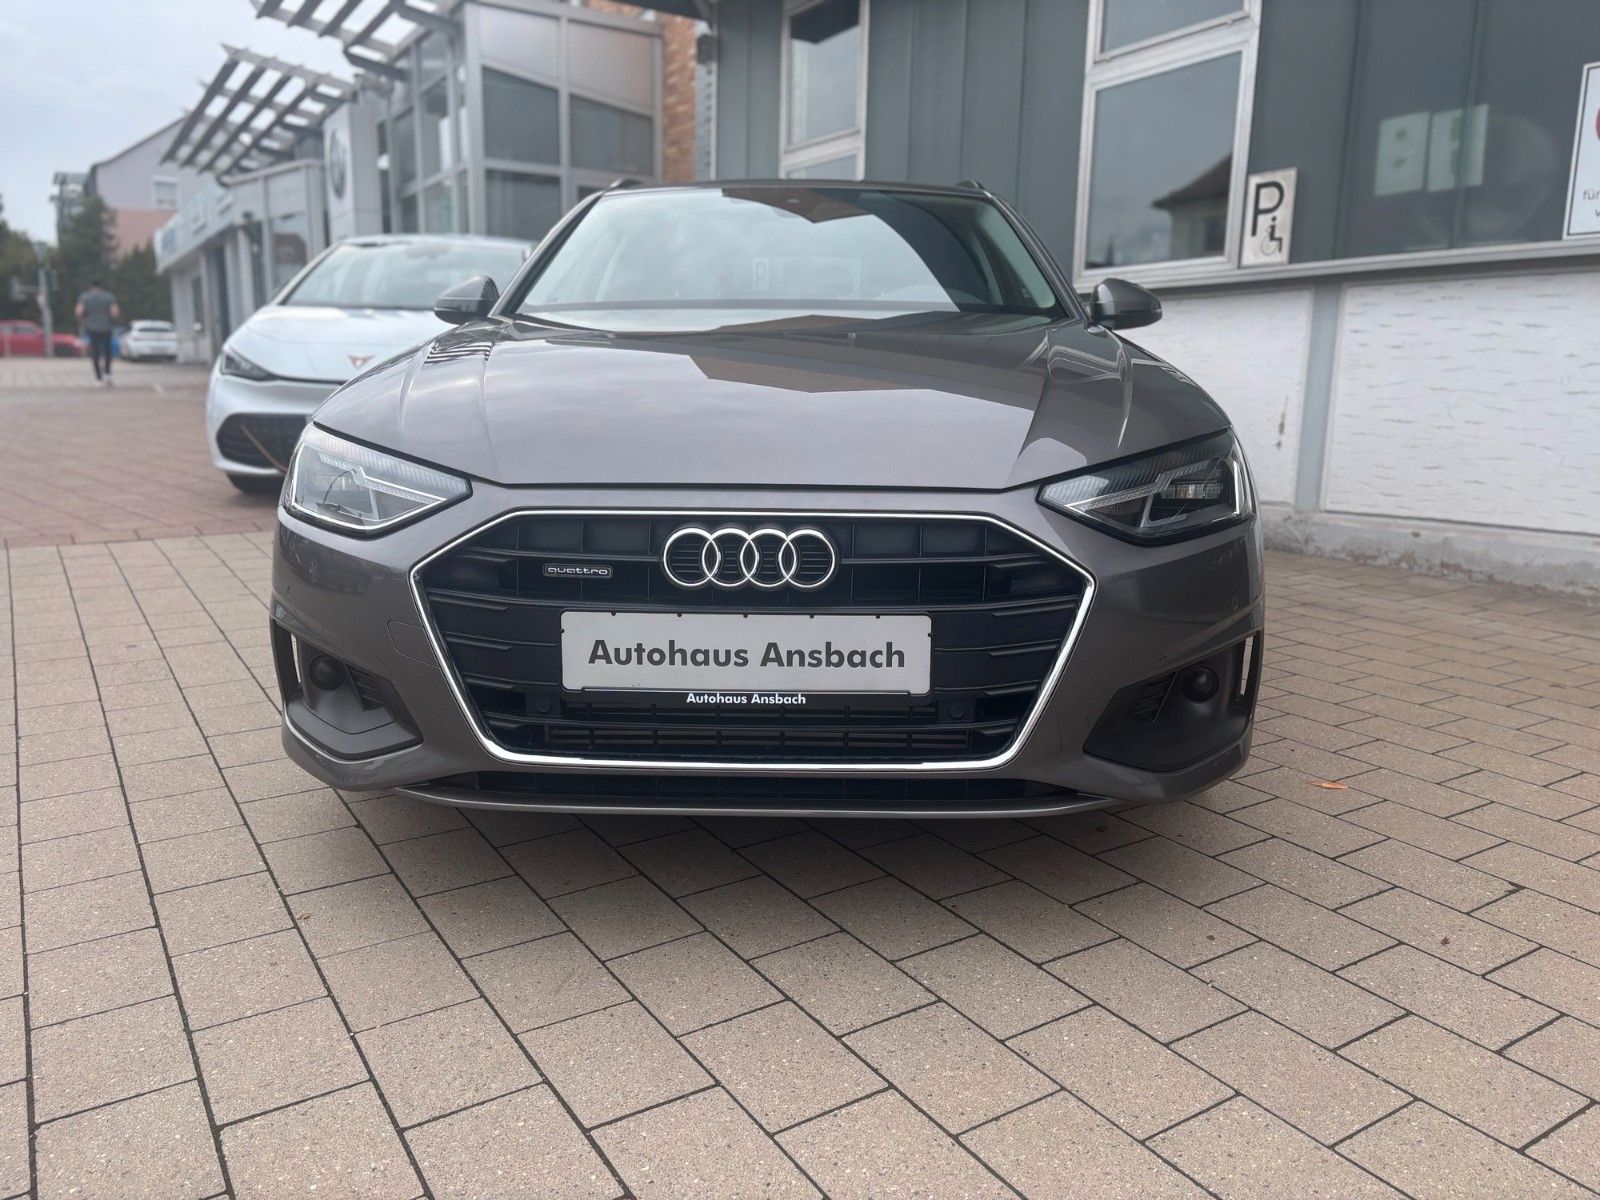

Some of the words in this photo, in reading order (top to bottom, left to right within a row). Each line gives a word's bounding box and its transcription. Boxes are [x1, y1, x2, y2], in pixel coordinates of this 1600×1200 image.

[1251, 181, 1284, 237] P
[547, 567, 608, 575] quattro
[588, 639, 750, 667] Autohaus
[760, 641, 905, 668] Ansbach
[686, 693, 748, 704] Autohaus
[751, 693, 806, 704] Ansbach
